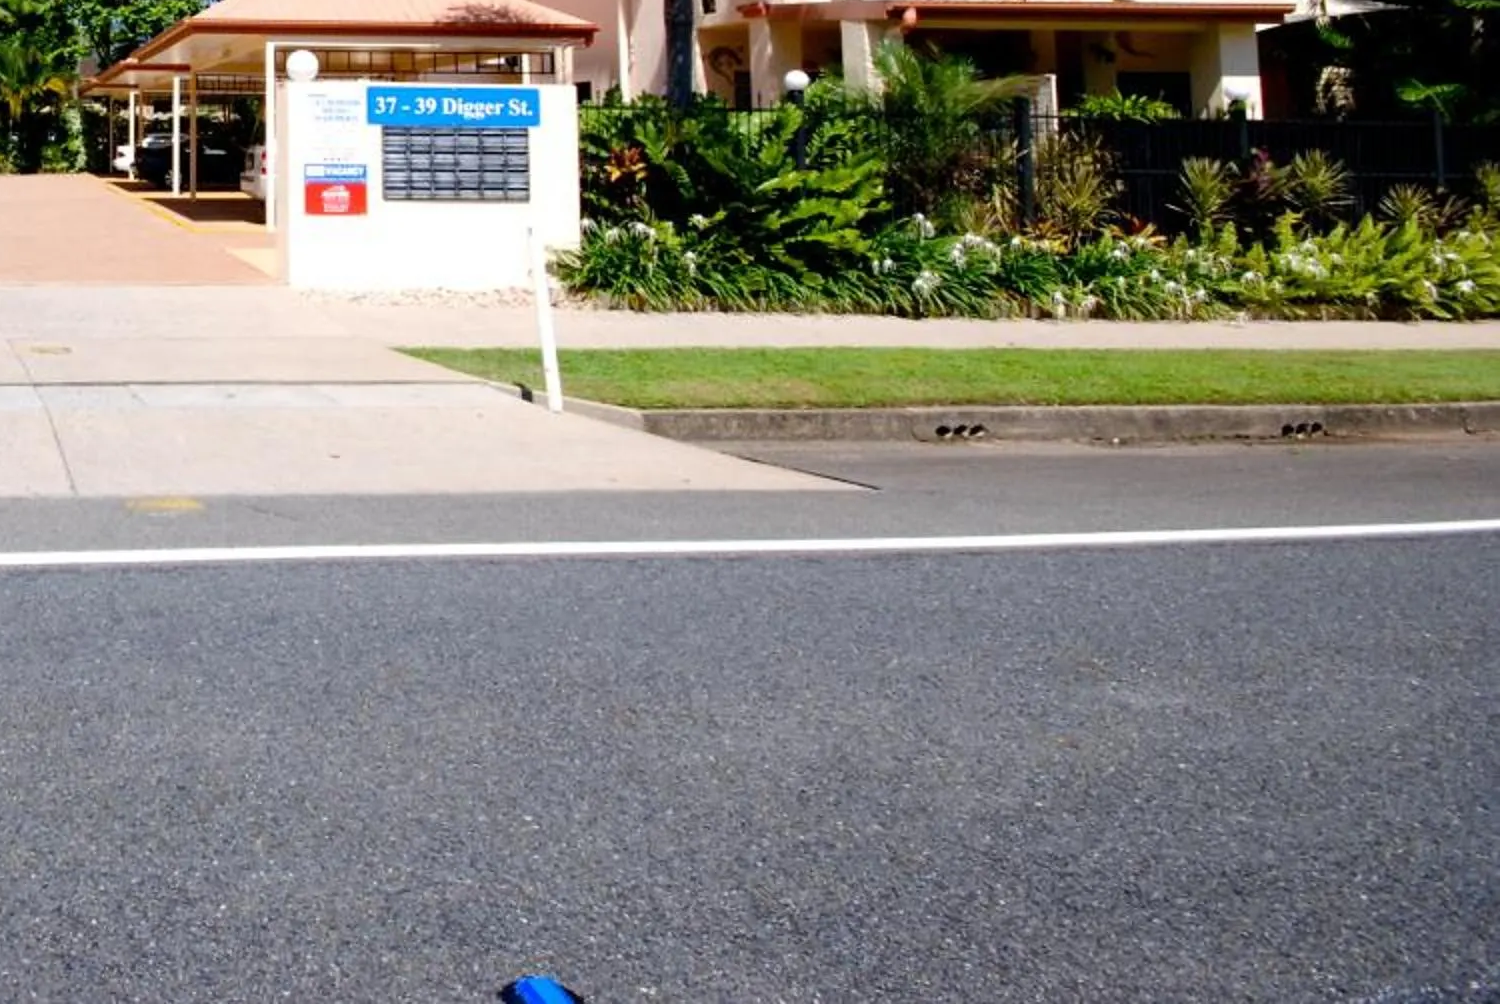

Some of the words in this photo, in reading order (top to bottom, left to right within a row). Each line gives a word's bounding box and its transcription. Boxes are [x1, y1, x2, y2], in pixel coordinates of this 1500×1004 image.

[374, 96, 397, 115] 37
[414, 97, 437, 116] 39
[442, 97, 504, 120] Digger
[508, 98, 533, 117] St.
